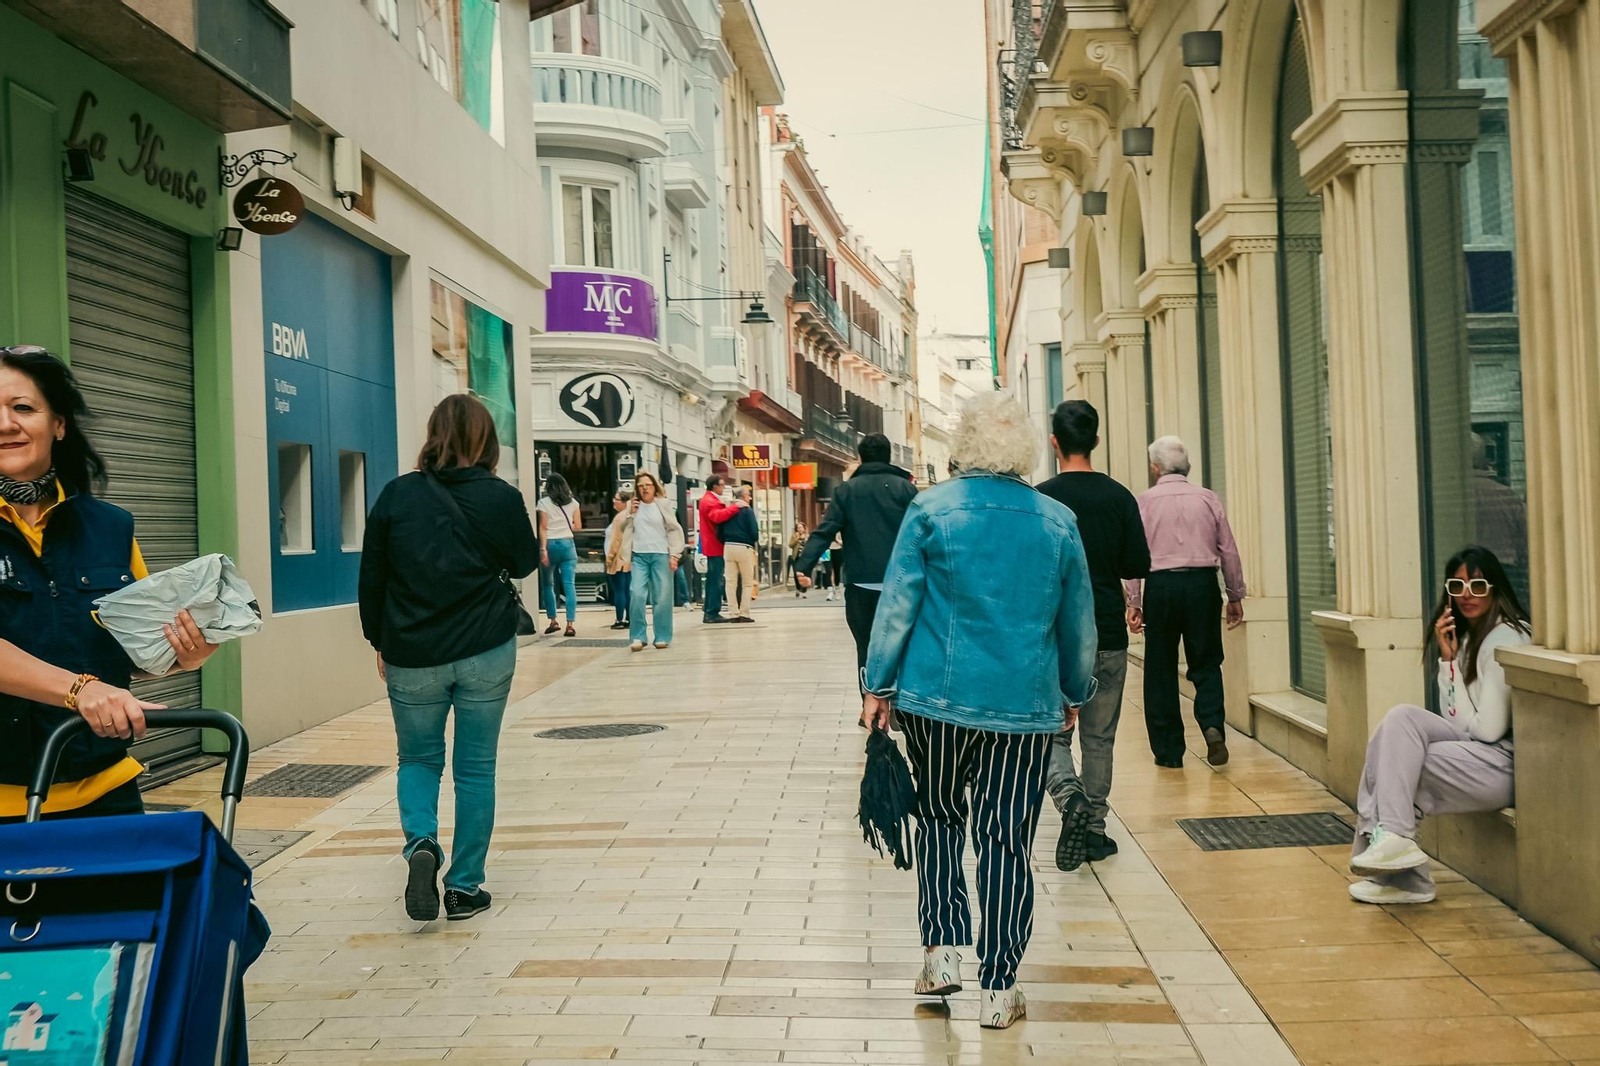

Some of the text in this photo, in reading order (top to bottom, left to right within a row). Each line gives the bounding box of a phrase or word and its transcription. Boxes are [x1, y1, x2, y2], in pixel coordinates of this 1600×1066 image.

[63, 90, 207, 209] La Ybense
[254, 179, 281, 197] La
[237, 202, 297, 223] Ybense
[583, 284, 633, 314] MC
[272, 322, 310, 360] BBVA
[733, 458, 769, 468] TABACOS
